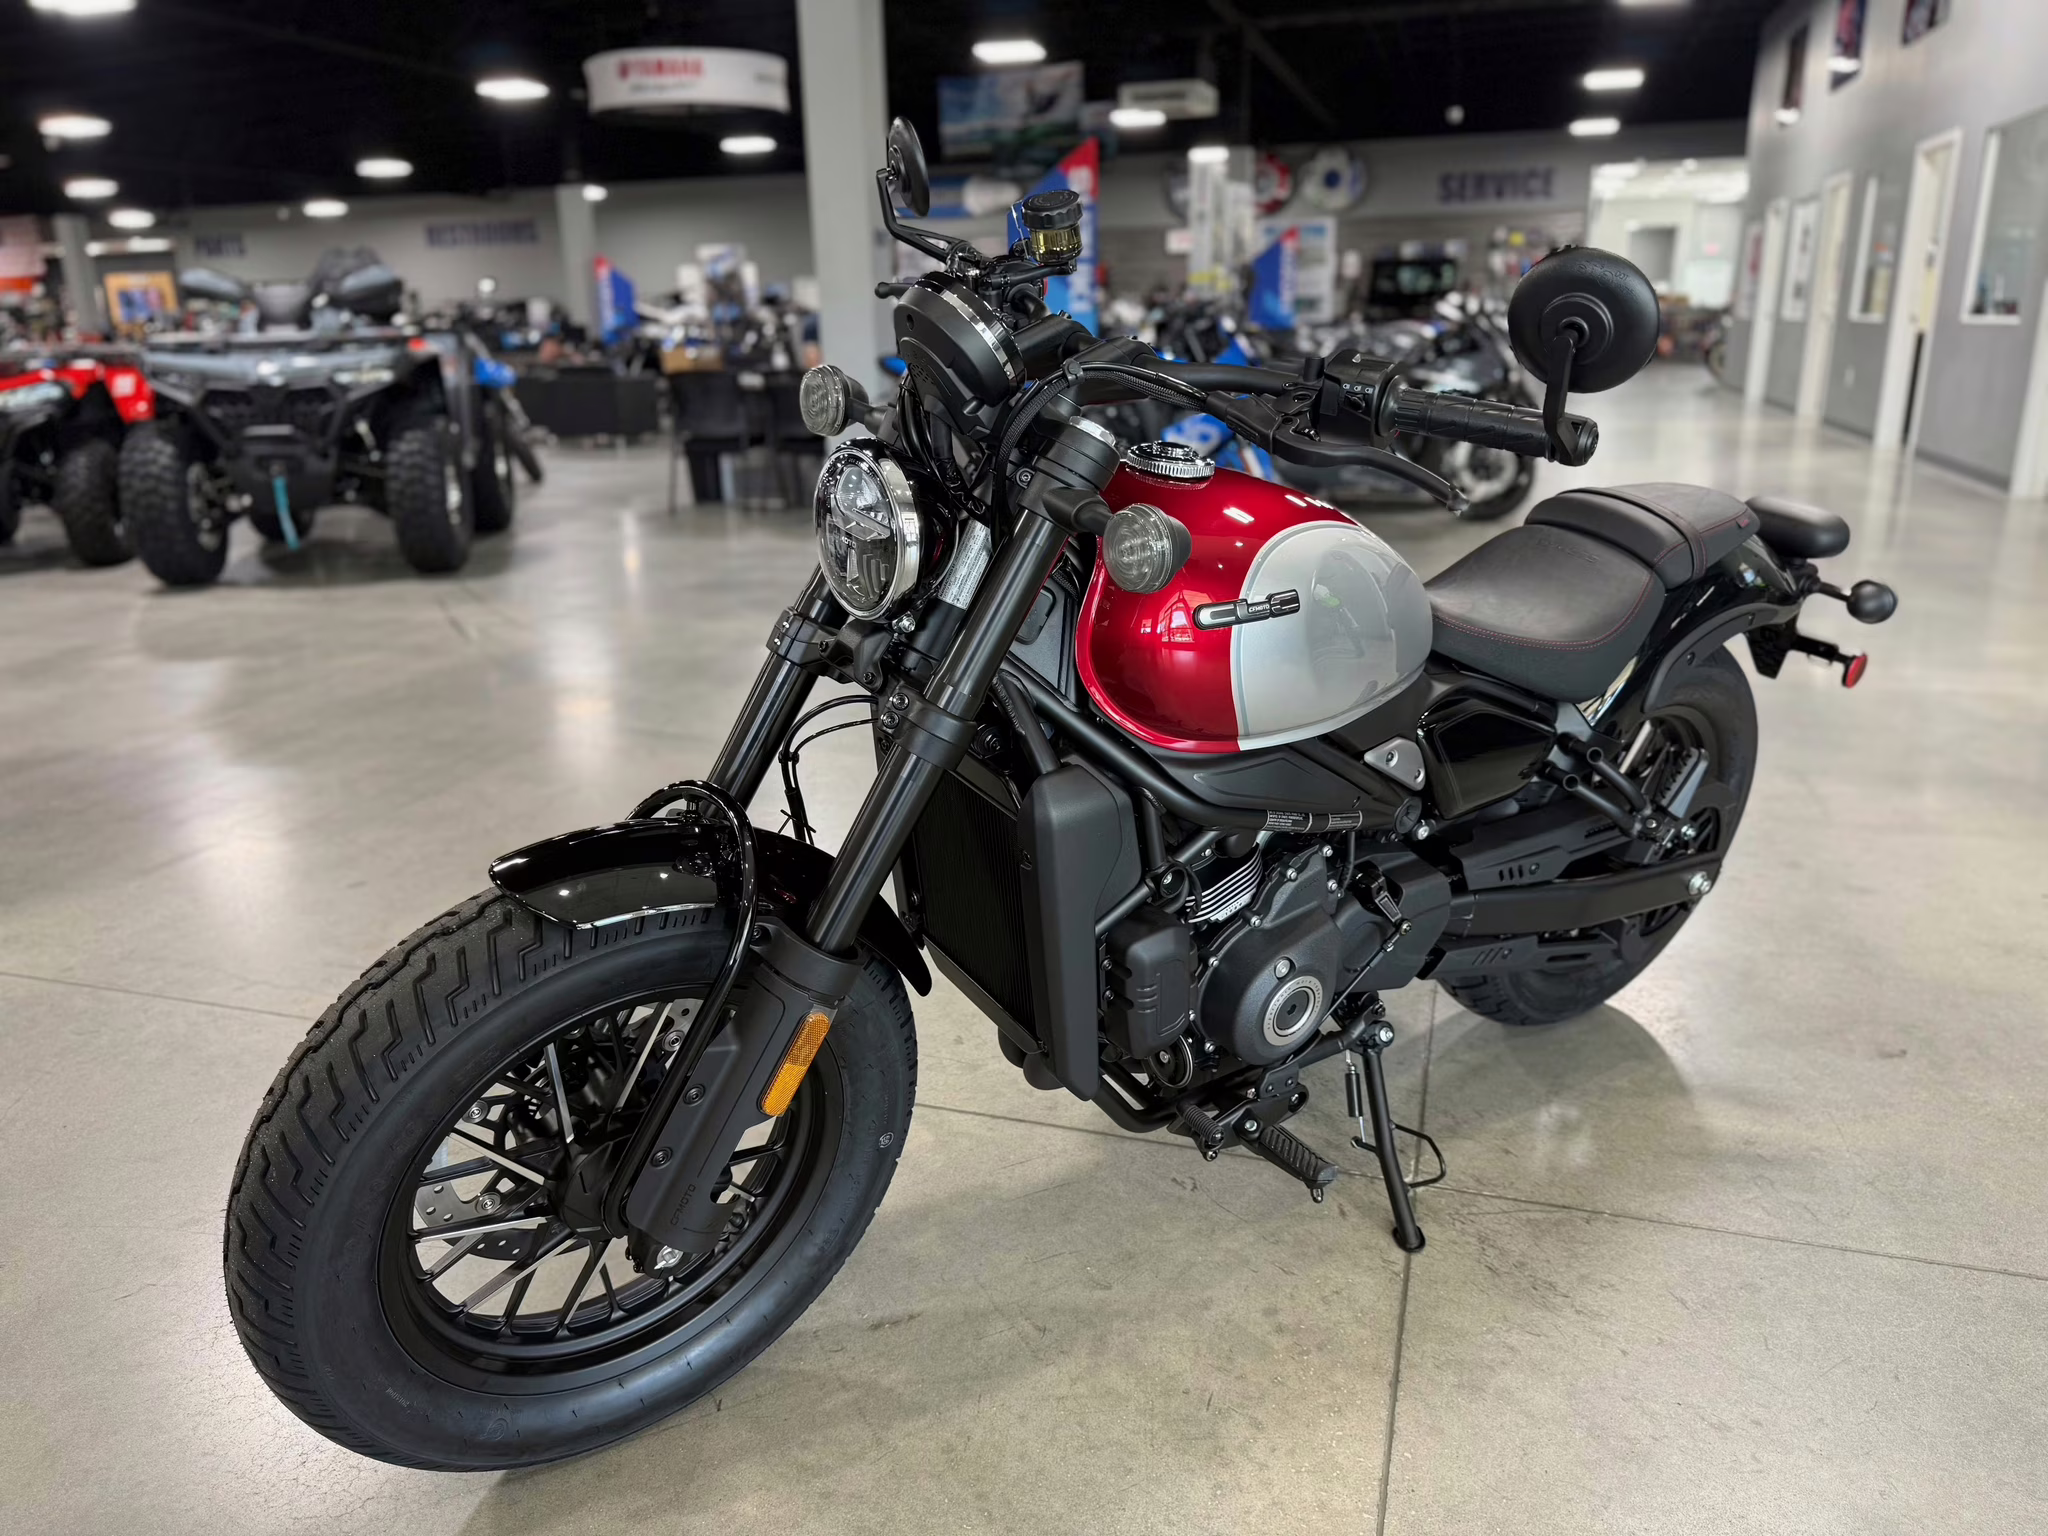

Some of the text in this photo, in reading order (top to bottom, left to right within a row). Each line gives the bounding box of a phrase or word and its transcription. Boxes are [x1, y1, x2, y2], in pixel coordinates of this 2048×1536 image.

[1438, 168, 1556, 204] SERVICE
[194, 234, 245, 258] PARTS
[670, 1184, 697, 1226] CFMOTO
